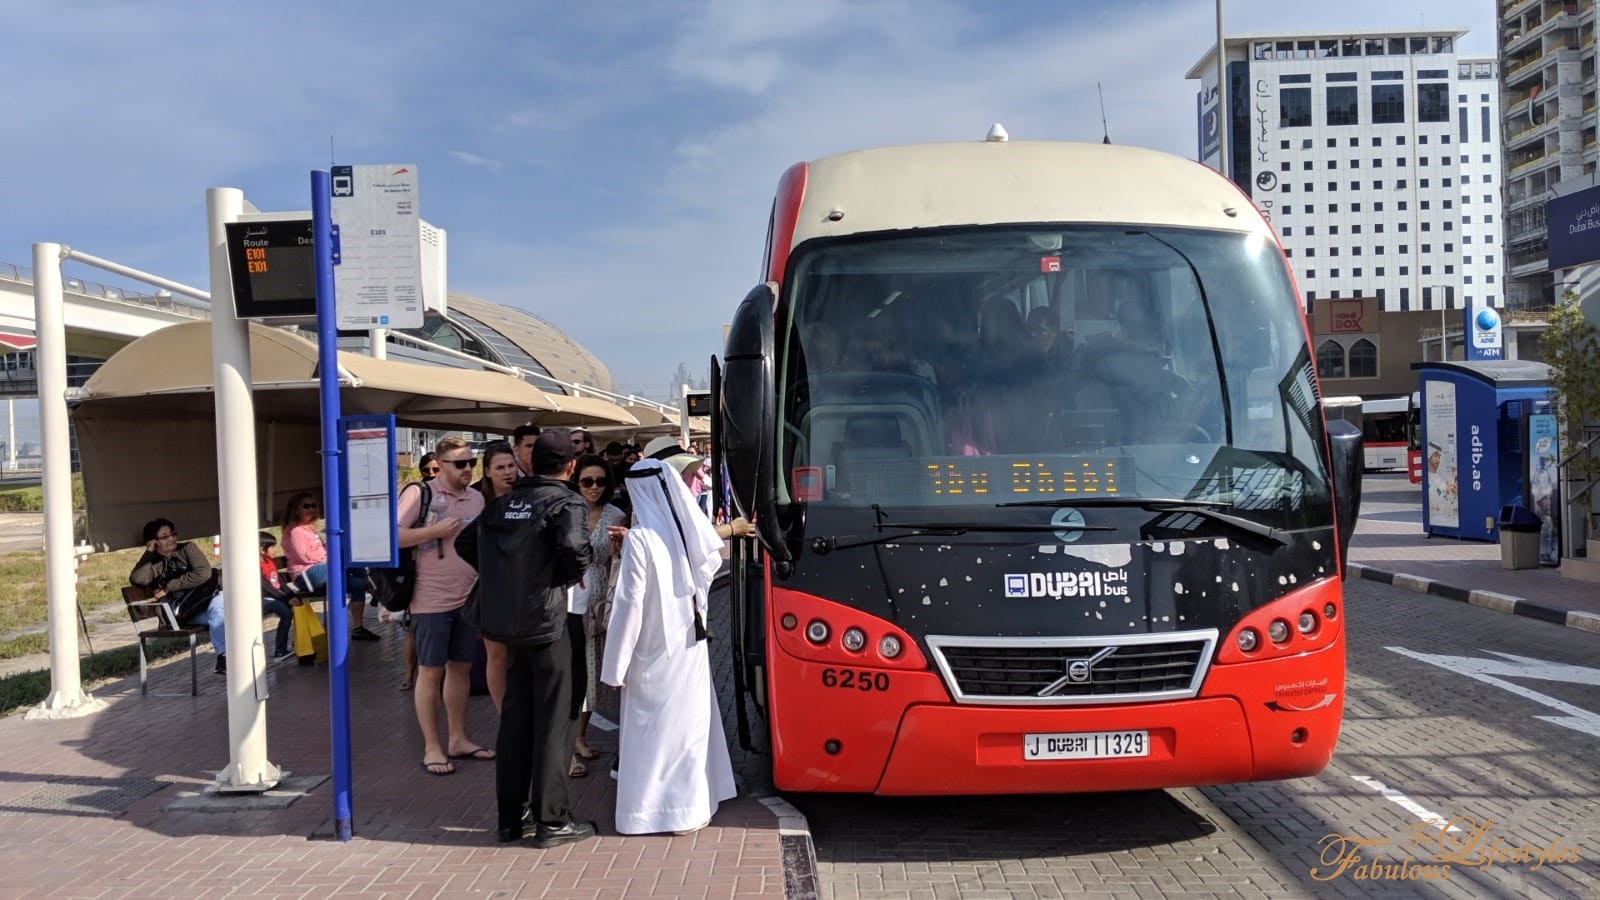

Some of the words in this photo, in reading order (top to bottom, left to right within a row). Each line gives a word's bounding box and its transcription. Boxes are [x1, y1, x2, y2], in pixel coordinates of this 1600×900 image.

[1569, 220, 1587, 234] Dubai
[243, 239, 269, 248] Route
[246, 248, 266, 260] E101
[248, 260, 268, 273] E101
[1335, 319, 1362, 330] BOX
[1483, 348, 1500, 356] ATM
[1471, 424, 1483, 491] adib.ae
[504, 511, 532, 520] SECURITY
[1102, 568, 1128, 583] باص
[1103, 583, 1128, 596] bus
[822, 668, 891, 692] 6250
[1030, 737, 1040, 756] J
[1094, 732, 1144, 756] 11329
